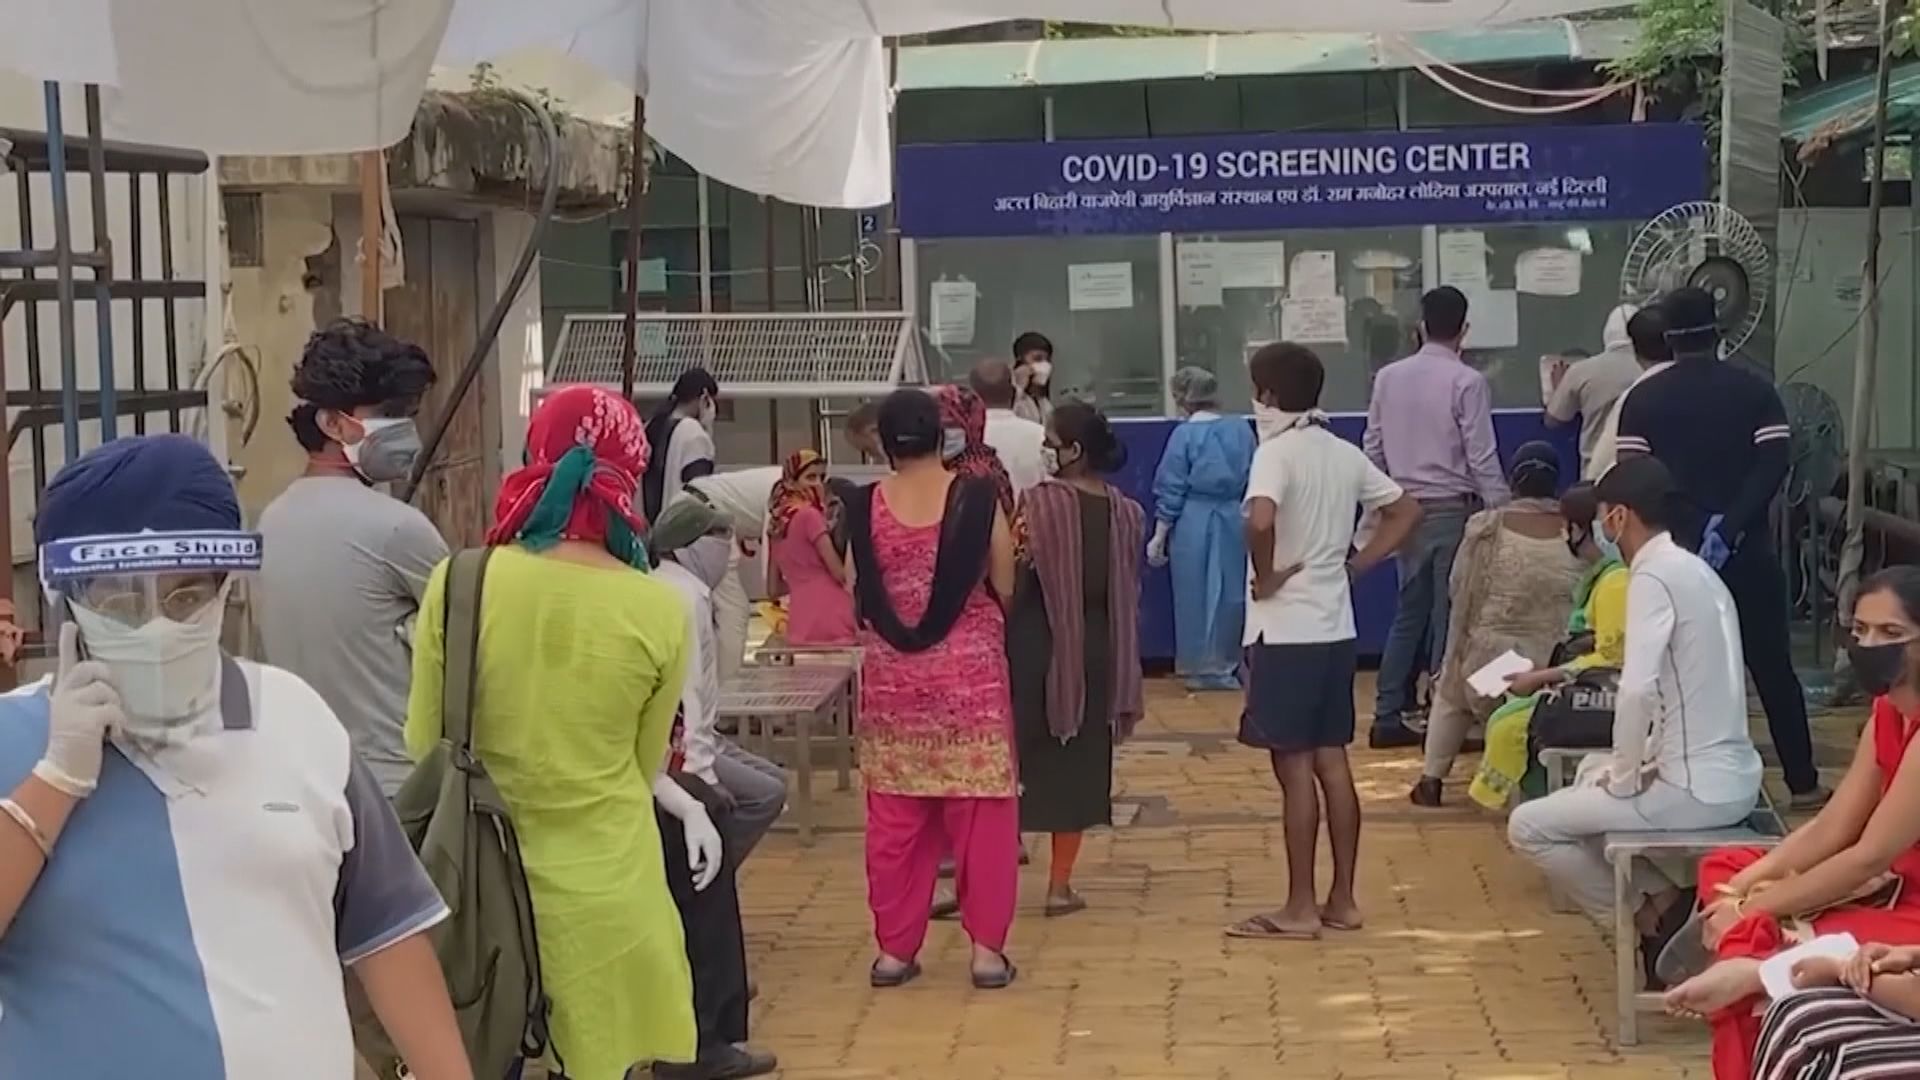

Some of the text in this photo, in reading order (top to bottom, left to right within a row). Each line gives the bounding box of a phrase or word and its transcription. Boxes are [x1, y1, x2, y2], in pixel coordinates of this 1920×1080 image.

[1062, 142, 1531, 183] COVID-19 SCREENING CENTER
[993, 196, 1029, 212] अटल
[1033, 190, 1077, 210] बिहारी
[1080, 189, 1137, 209] वाजपेयी
[1327, 187, 1351, 202] राम
[1355, 181, 1405, 202] मनोहर
[1409, 180, 1460, 199] लोहिया
[1535, 176, 1559, 196] नई
[1562, 175, 1608, 195] दिल्ली
[863, 215, 875, 231] 2
[79, 540, 254, 560] Face Shield
